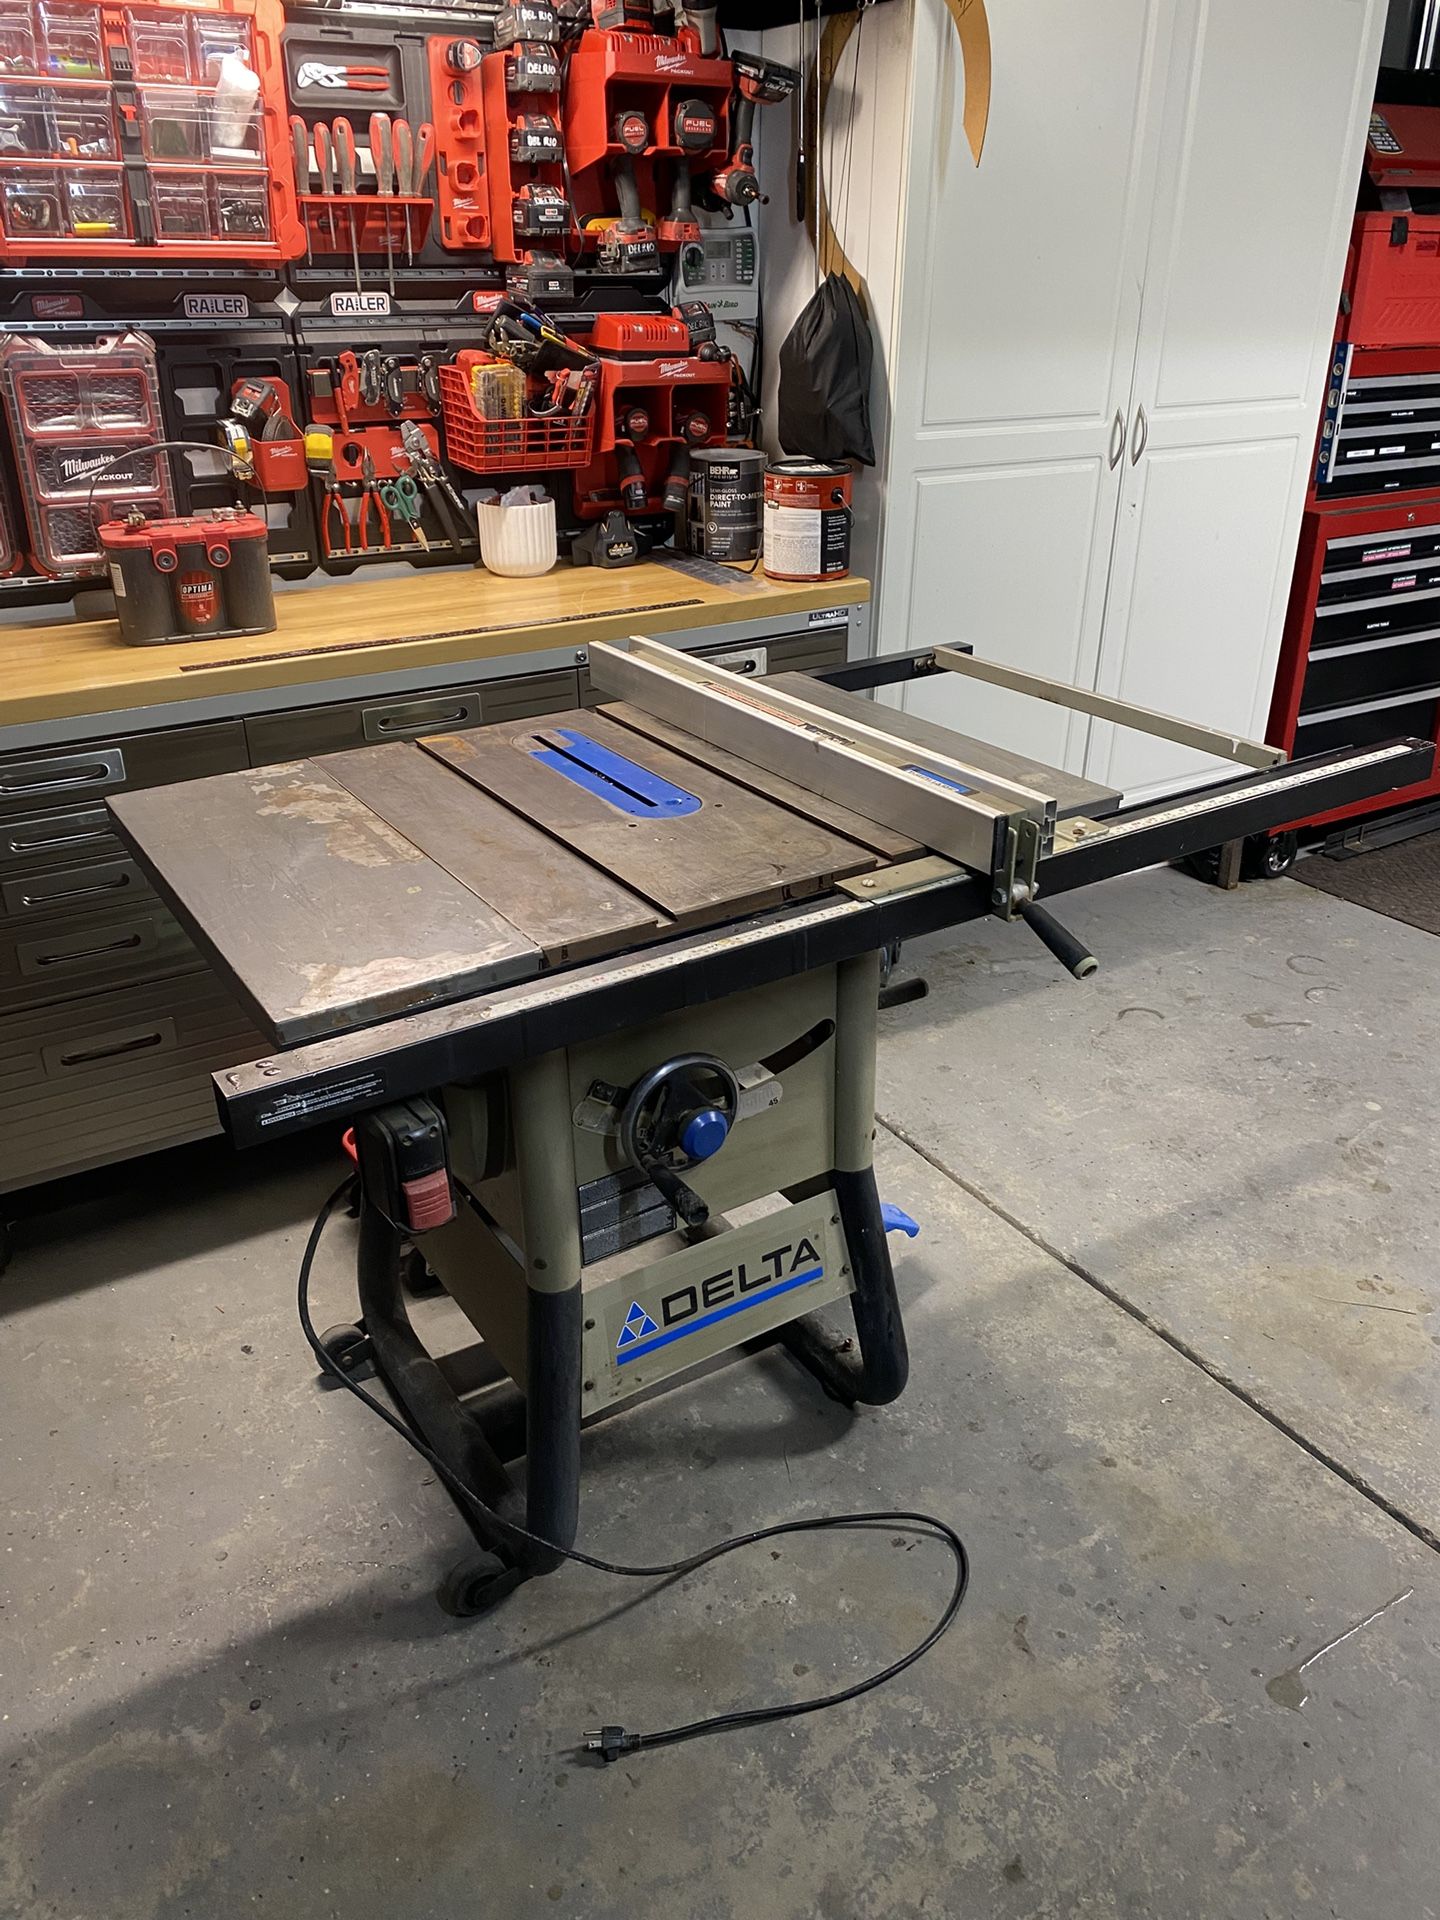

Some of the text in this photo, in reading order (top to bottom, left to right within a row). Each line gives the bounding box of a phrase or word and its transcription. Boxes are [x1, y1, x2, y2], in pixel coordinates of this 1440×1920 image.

[538, 10, 553, 22] RIO
[335, 297, 385, 312] RAILER
[59, 453, 117, 477] Milwaukee
[709, 465, 730, 475] BEHR
[91, 472, 134, 481] PACKOUT
[709, 500, 732, 508] PAINT
[182, 583, 213, 594] OPTIMA
[768, 1097, 779, 1107] 45
[661, 1237, 821, 1327] DELTA
